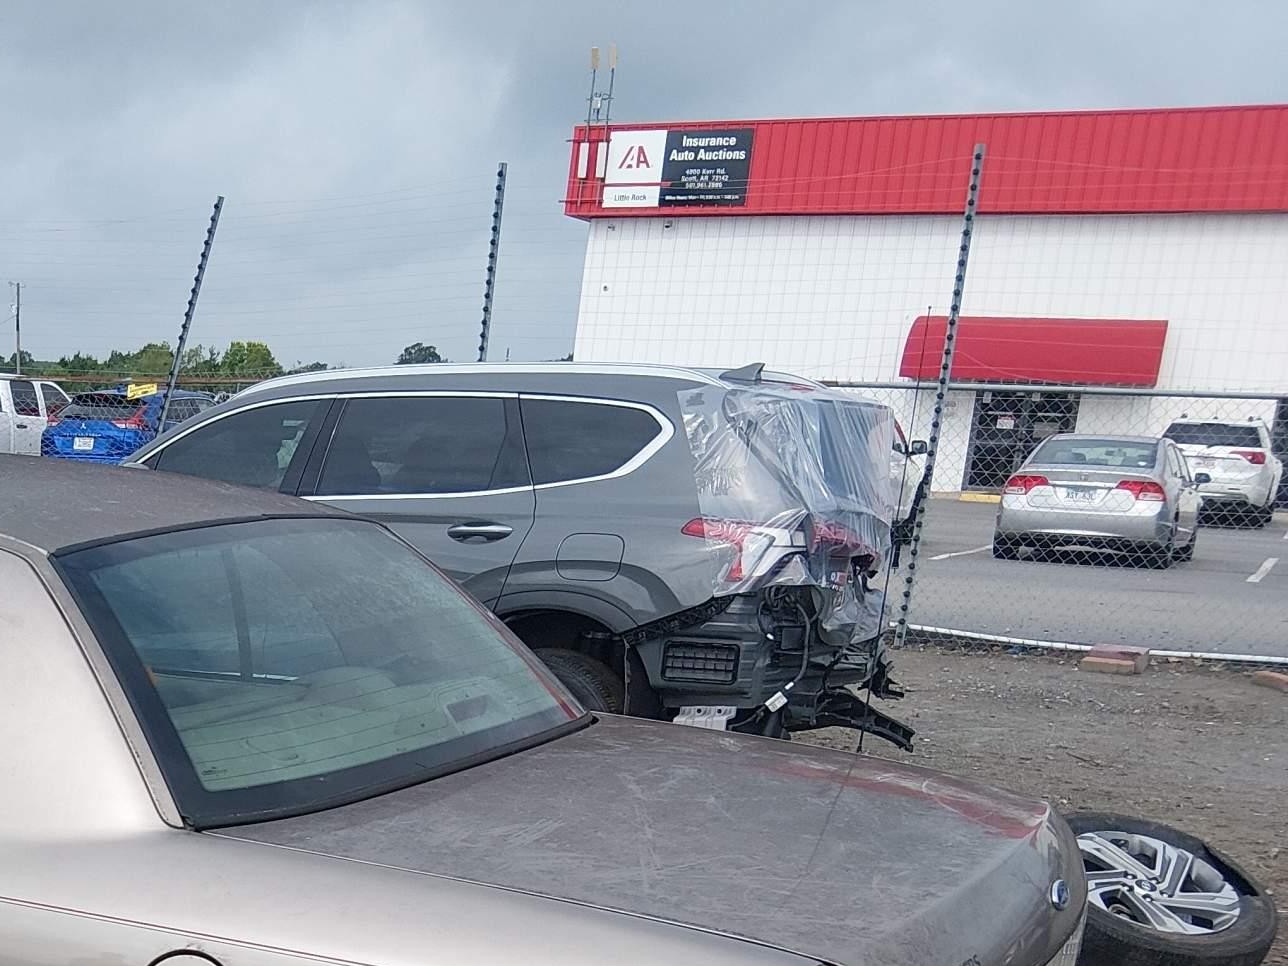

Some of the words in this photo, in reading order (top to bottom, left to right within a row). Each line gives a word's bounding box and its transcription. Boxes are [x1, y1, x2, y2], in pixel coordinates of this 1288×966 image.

[682, 135, 737, 147] Insurance
[669, 149, 695, 161] Auto
[696, 148, 746, 161] Auctions
[614, 193, 630, 202] Little
[631, 193, 647, 201] Rock
